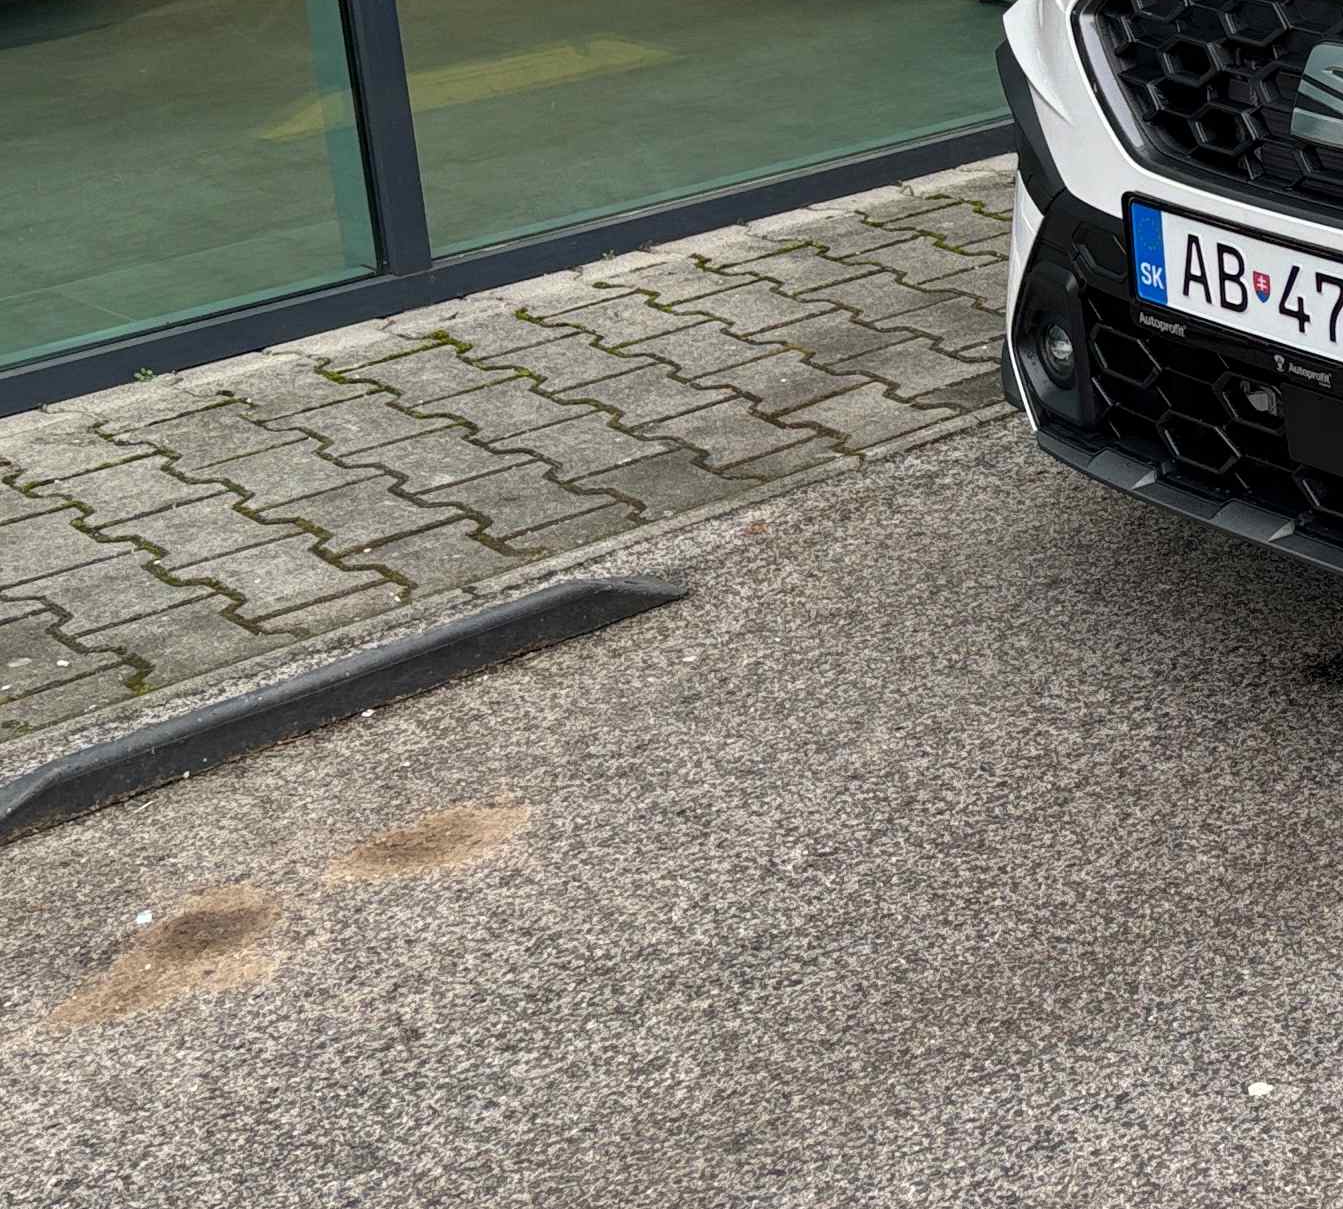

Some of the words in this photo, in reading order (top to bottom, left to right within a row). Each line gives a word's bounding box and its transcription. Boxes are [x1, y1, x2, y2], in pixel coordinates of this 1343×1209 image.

[1140, 262, 1165, 289] SK
[1183, 234, 1248, 313] AB
[1139, 311, 1185, 337] Autoprofit
[1288, 362, 1332, 385] Autoprofit
